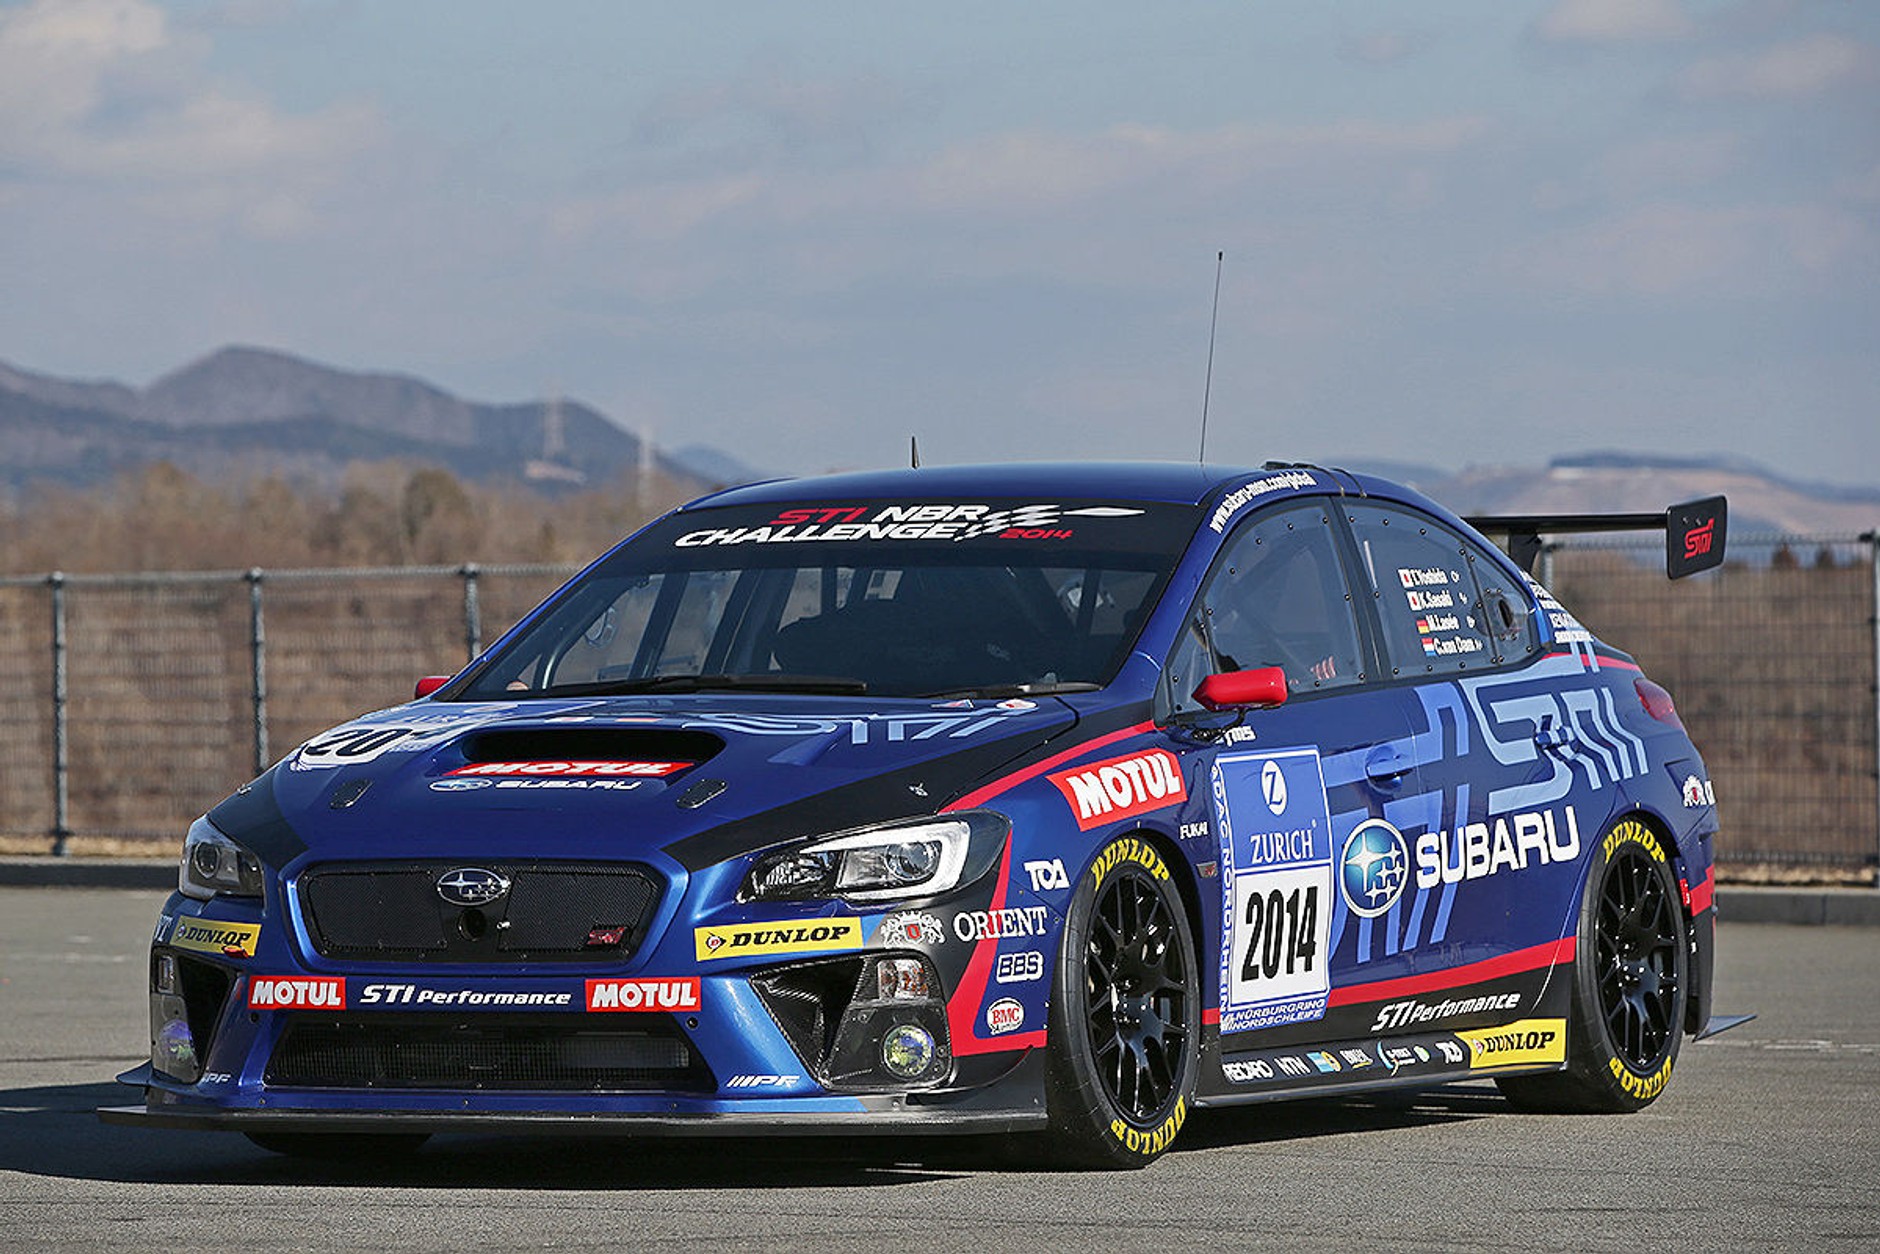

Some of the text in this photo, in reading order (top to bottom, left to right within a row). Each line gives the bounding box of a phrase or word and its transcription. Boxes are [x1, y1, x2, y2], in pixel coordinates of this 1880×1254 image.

[769, 503, 989, 525] STI NBR
[674, 522, 959, 548] CHALLENGE
[999, 528, 1073, 540] 2014
[460, 762, 673, 775] MOTUL
[495, 780, 642, 790] SUBARU
[1066, 753, 1181, 820] MOTUL
[1209, 763, 1229, 839] ADAC
[1250, 829, 1314, 864] ZURICH
[1415, 805, 1581, 890] SUBARU
[1602, 821, 1666, 864] DUNLOP
[1091, 838, 1170, 892] DUNLOP
[186, 926, 251, 947] DUNLOP
[729, 926, 850, 949] DUNLOP
[952, 906, 1049, 943] ORIENT
[1240, 886, 1318, 982] 2014
[998, 952, 1042, 979] BBS
[251, 981, 341, 1006] MOTUL
[359, 983, 573, 1006] STI Performance
[591, 982, 698, 1008] MOTUL
[991, 1007, 1020, 1025] BMC
[1370, 993, 1521, 1032] STI Performance
[1483, 1031, 1556, 1053] DUNLOP
[1221, 1059, 1274, 1082] RECARO
[1608, 1055, 1672, 1099] DUNLOP
[1111, 1095, 1186, 1155] DUNLOP
